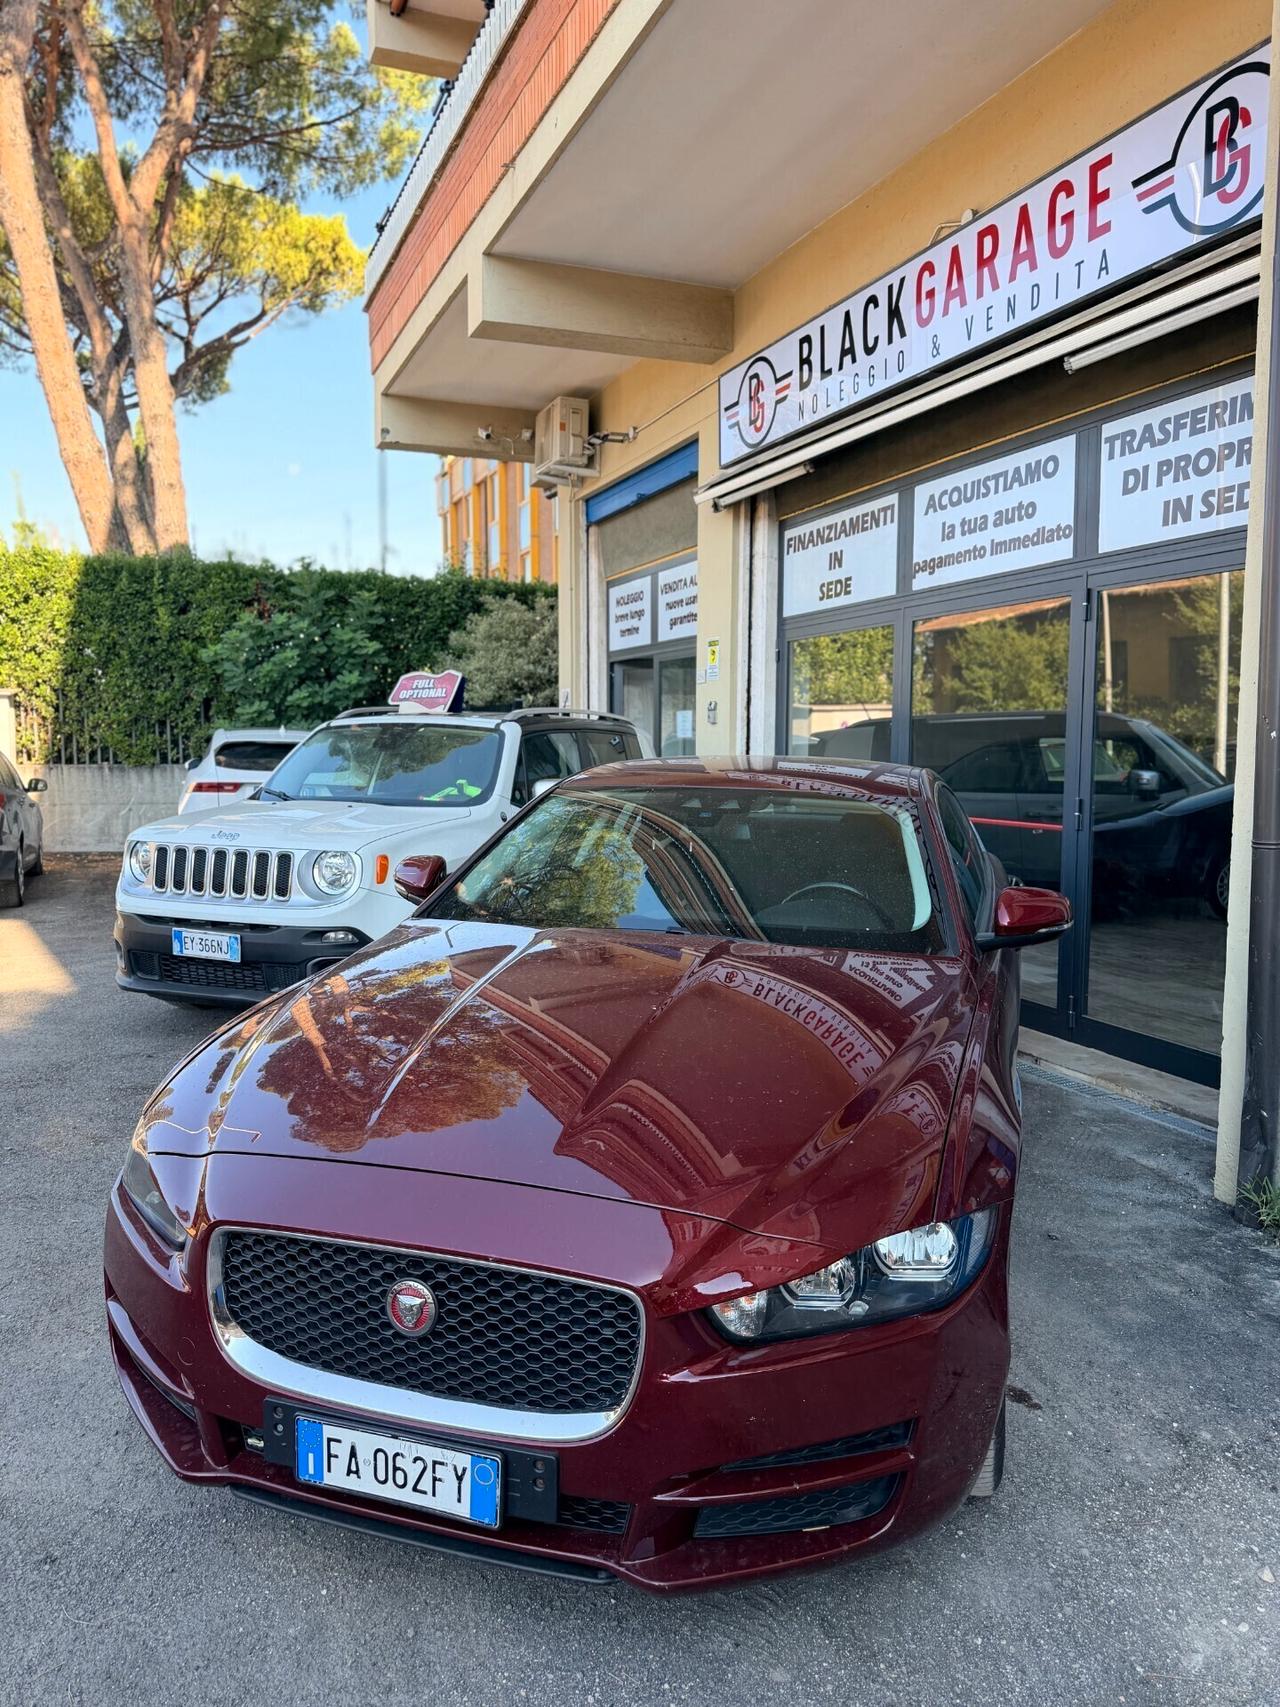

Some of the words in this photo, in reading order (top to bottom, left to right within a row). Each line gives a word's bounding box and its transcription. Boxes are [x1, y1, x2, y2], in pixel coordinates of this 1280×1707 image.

[798, 350, 905, 421] NOLEGGIO
[931, 334, 941, 358] &
[965, 249, 1110, 341] VENDITA
[924, 454, 1060, 516] ACQUISTIAMO
[1122, 464, 1150, 497] DI
[941, 521, 956, 542] la
[960, 513, 988, 537] tua
[993, 500, 1037, 528] auto
[1162, 494, 1194, 527] IN
[786, 503, 895, 555] FINANZIAMENTI
[828, 549, 843, 571] IN
[913, 544, 987, 579] pagamento
[660, 577, 688, 595] VENDITA
[819, 576, 852, 601] SEDE
[616, 590, 644, 608] NOLEGGIO
[666, 598, 683, 611] nuove
[630, 609, 645, 621] lungo
[399, 688, 447, 699] OPTIONAL
[412, 679, 435, 689] FULL
[211, 830, 240, 841] Jeep
[183, 936, 195, 951] EY
[198, 937, 229, 955] 366NJ
[326, 1437, 361, 1479] FA
[373, 1448, 467, 1503] 062FY
